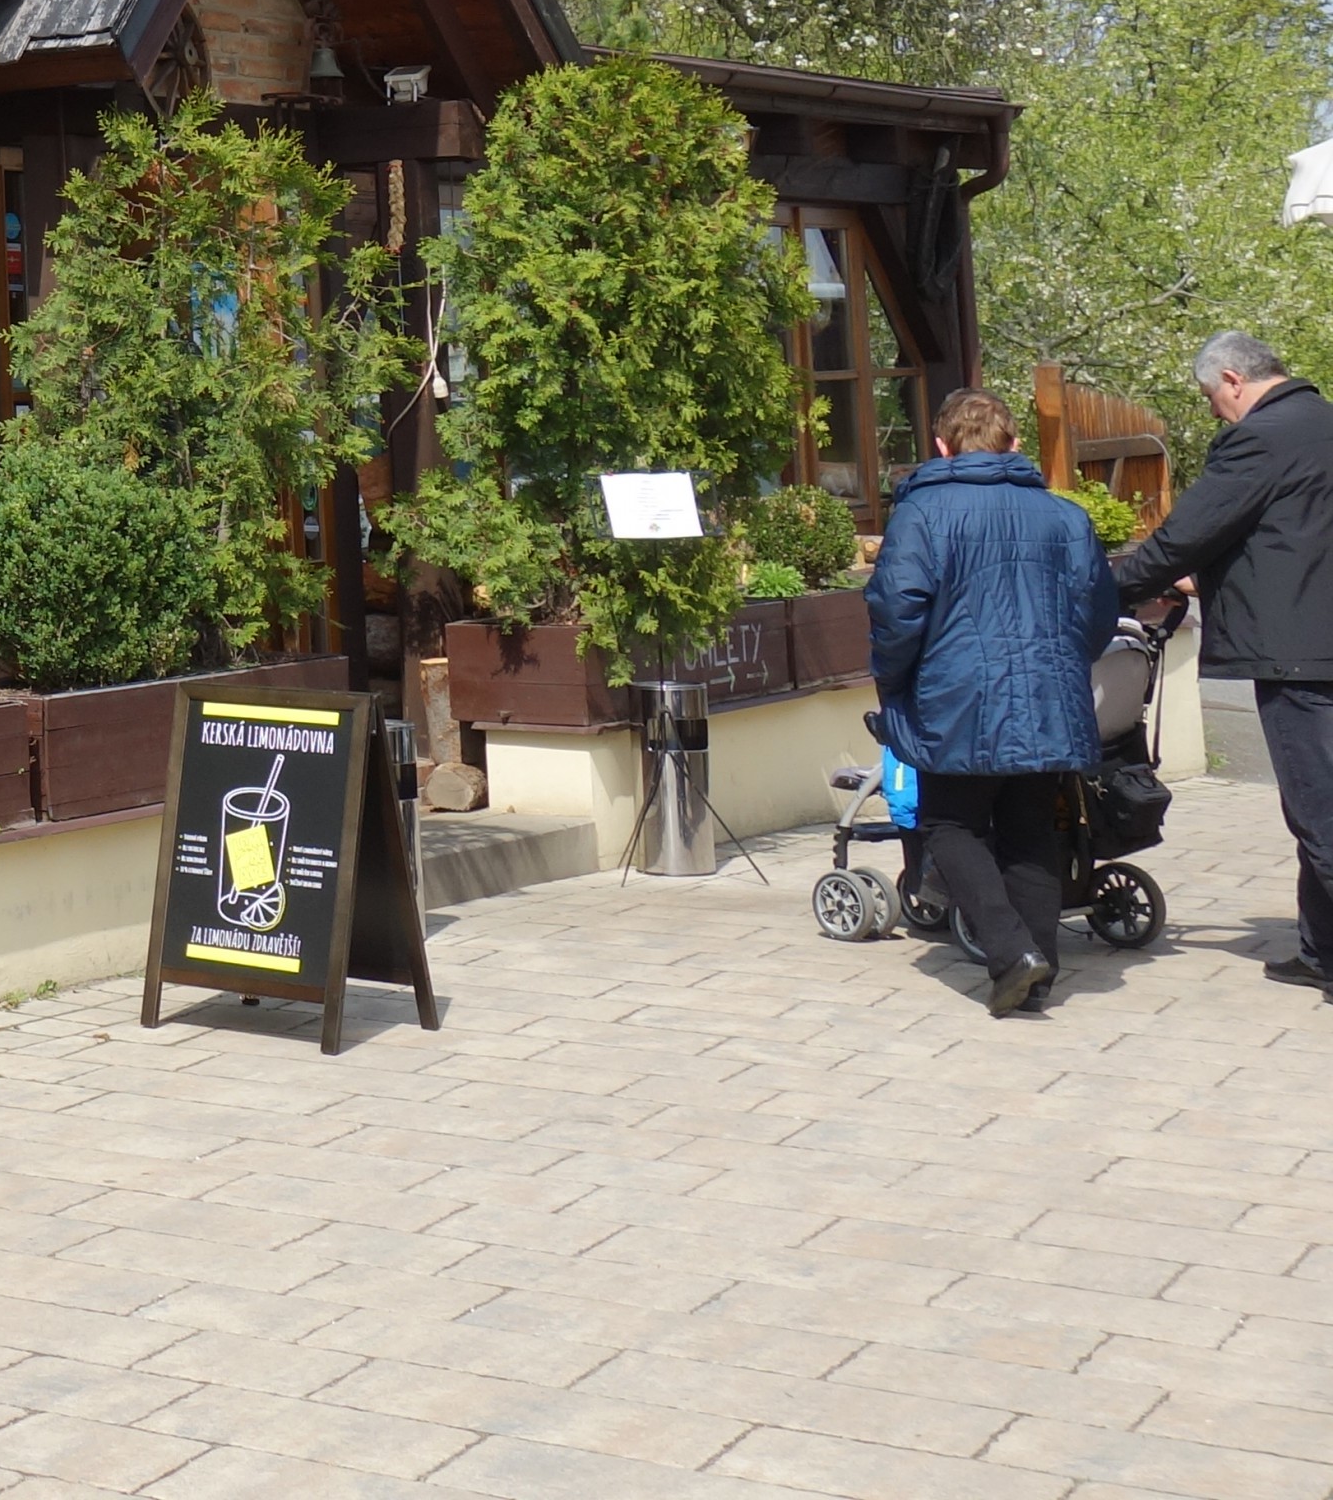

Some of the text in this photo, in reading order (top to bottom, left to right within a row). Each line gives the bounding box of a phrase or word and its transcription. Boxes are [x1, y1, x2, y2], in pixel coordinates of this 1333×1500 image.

[201, 720, 334, 754] KERSKÁ LIMONÁDOVNA
[191, 926, 301, 957] ZA LIMONÁDU ZDRAVĚJŠÍ!
